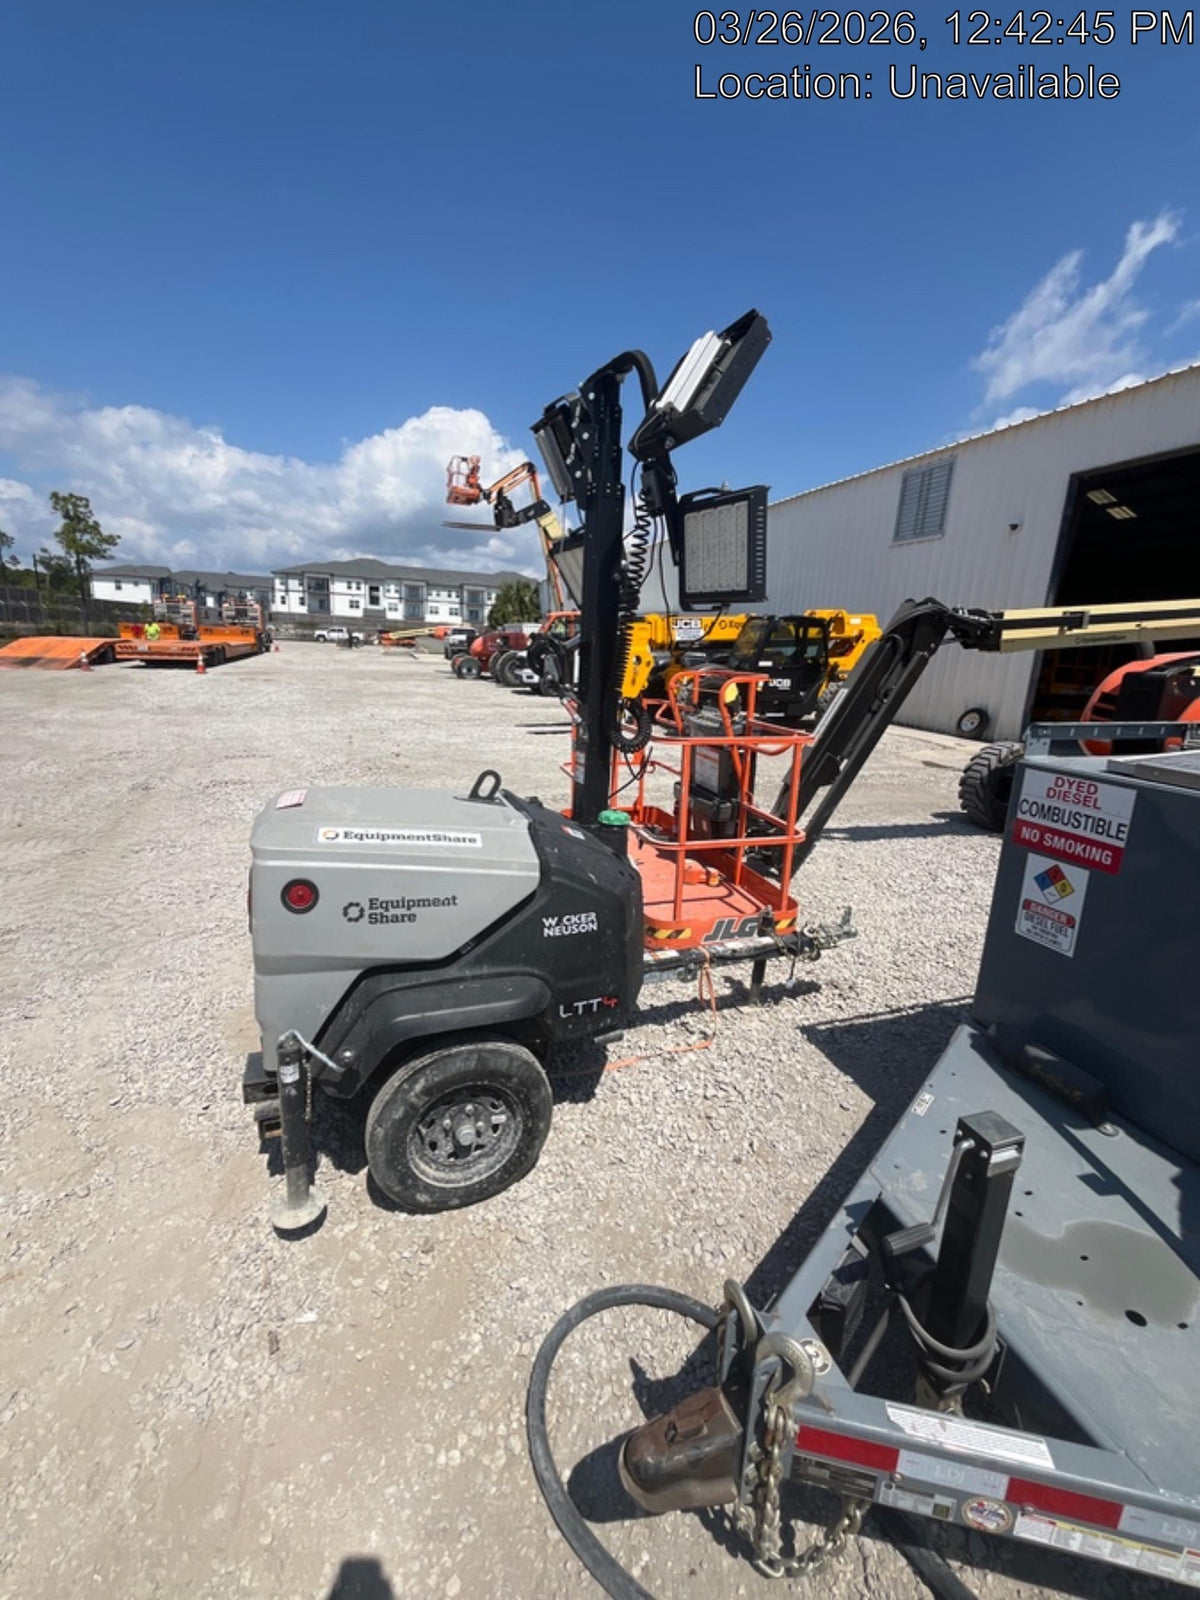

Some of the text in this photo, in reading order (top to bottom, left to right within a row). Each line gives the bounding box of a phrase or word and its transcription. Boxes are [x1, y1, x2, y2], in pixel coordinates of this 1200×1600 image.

[672, 619, 702, 629] JCB
[769, 678, 791, 687] JCB
[1054, 776, 1098, 796] DYED
[1046, 787, 1101, 810] DIESEL
[1020, 799, 1128, 842] COMBUSTIBLE
[343, 831, 478, 844] EquipmentShare
[1020, 826, 1113, 865] NO SMOKING
[368, 895, 459, 912] Equipment
[368, 912, 417, 925] Share
[542, 912, 597, 927] WCKER
[543, 921, 598, 937] NEUSON
[702, 917, 760, 943] JLG
